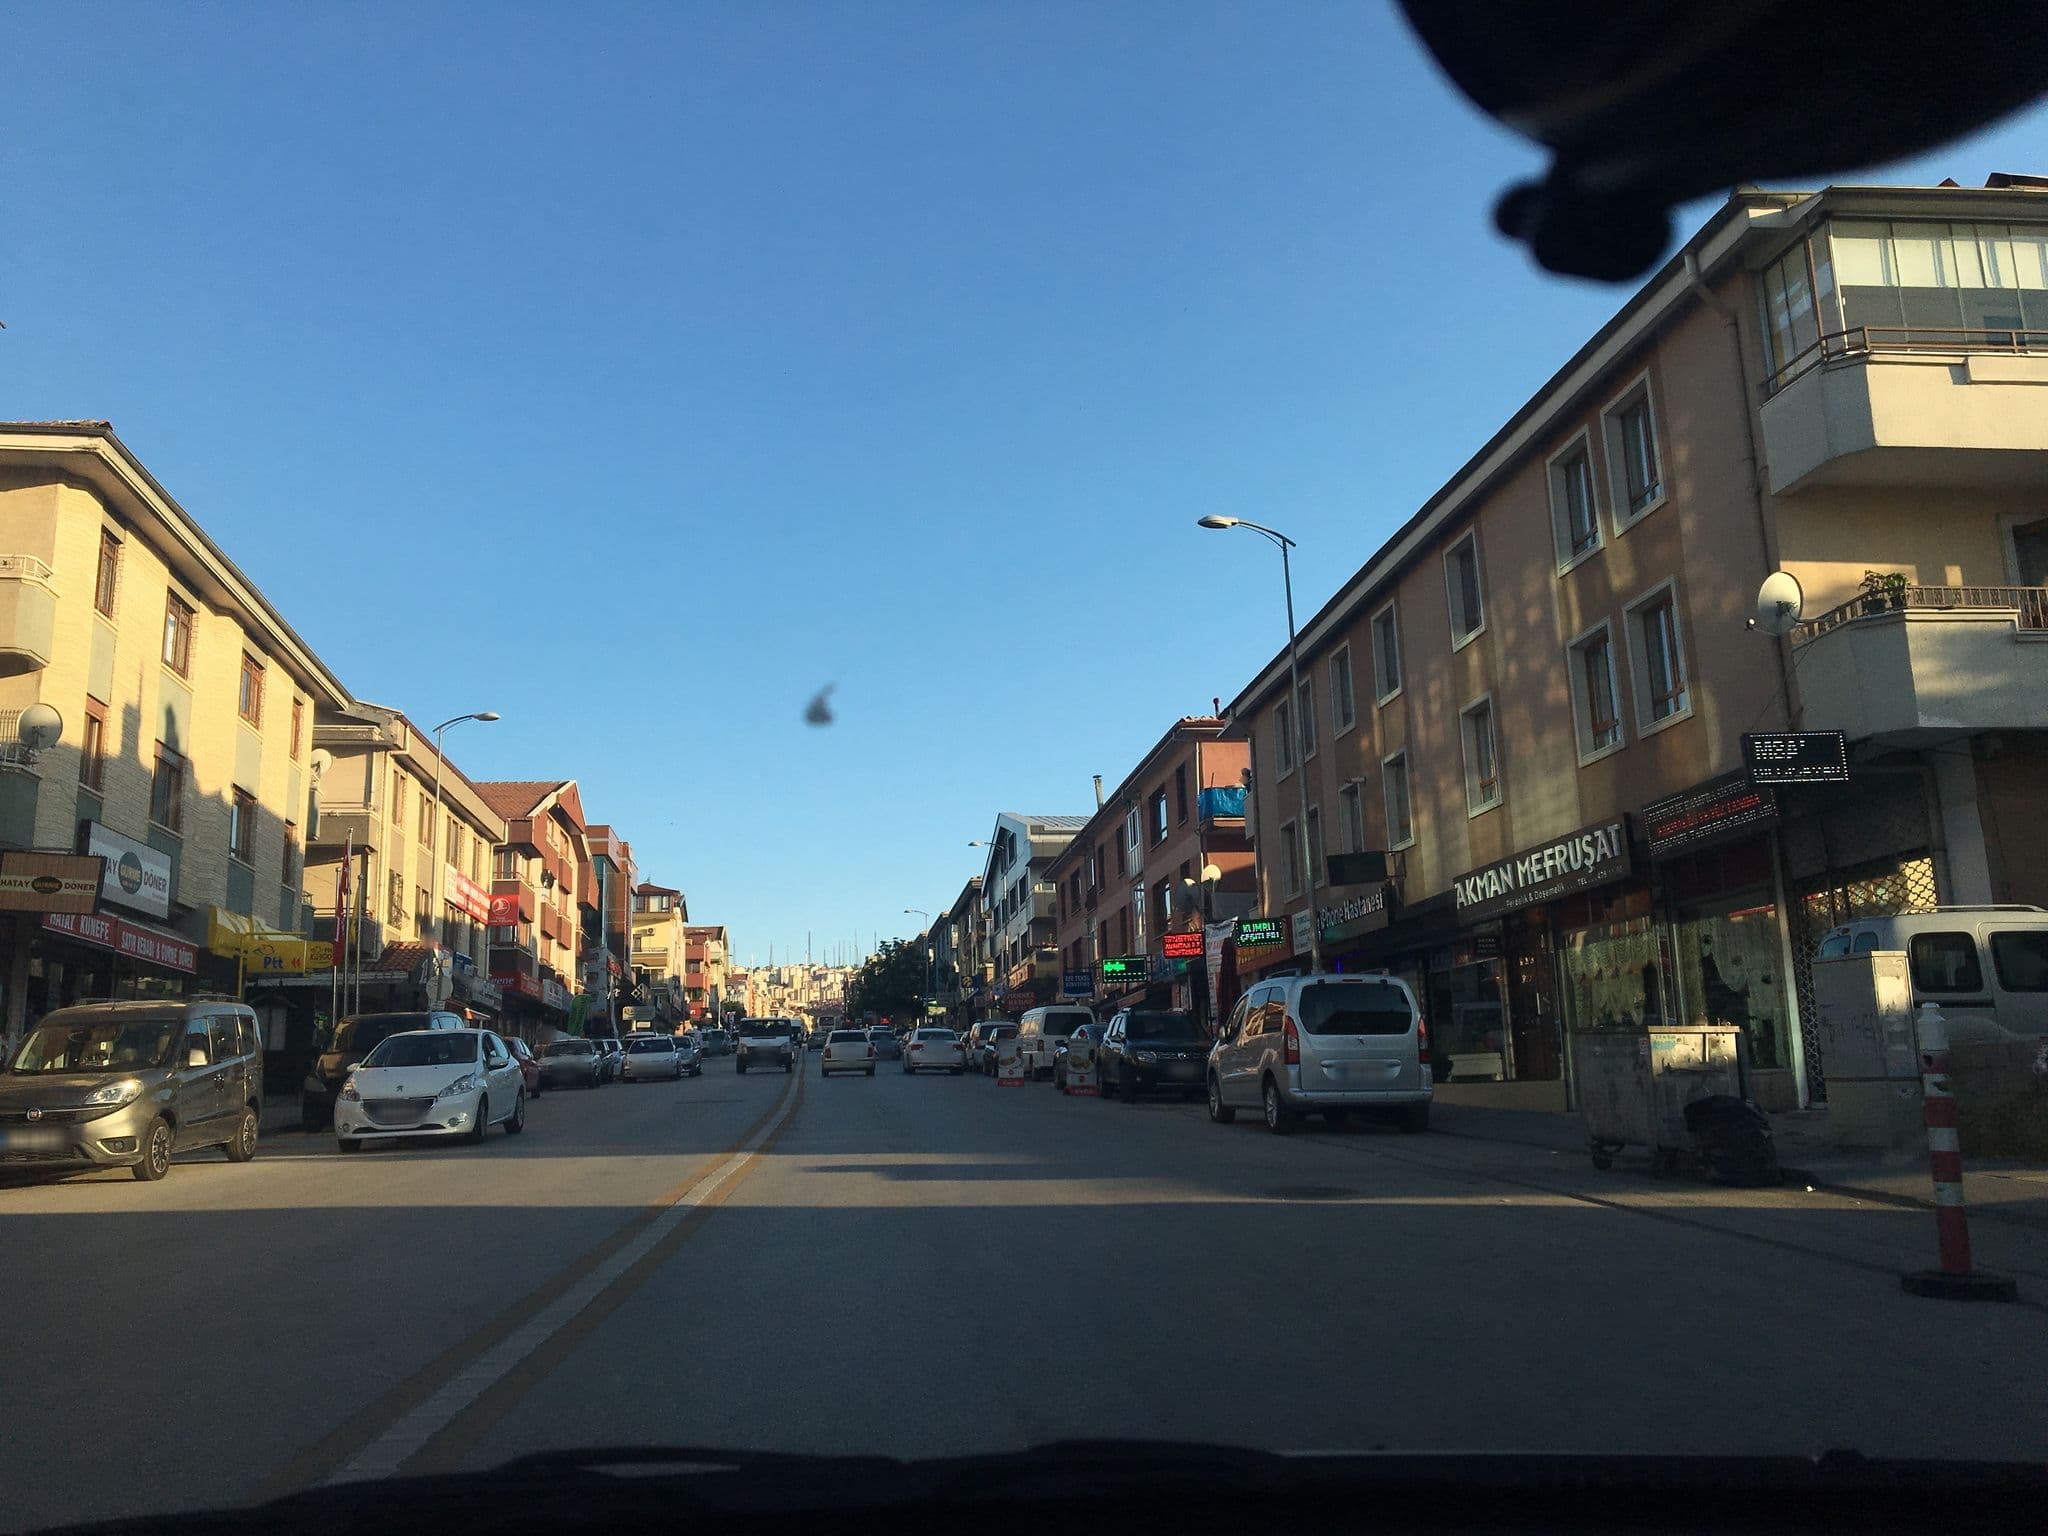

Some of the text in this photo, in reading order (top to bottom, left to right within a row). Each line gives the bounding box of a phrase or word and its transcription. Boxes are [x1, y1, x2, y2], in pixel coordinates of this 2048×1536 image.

[1454, 863, 1515, 909] AKMAN
[1516, 823, 1622, 888] MEFRUŞAT
[0, 880, 30, 888] HATAY
[144, 869, 167, 893] DÖNER
[263, 957, 283, 968] Ptt
